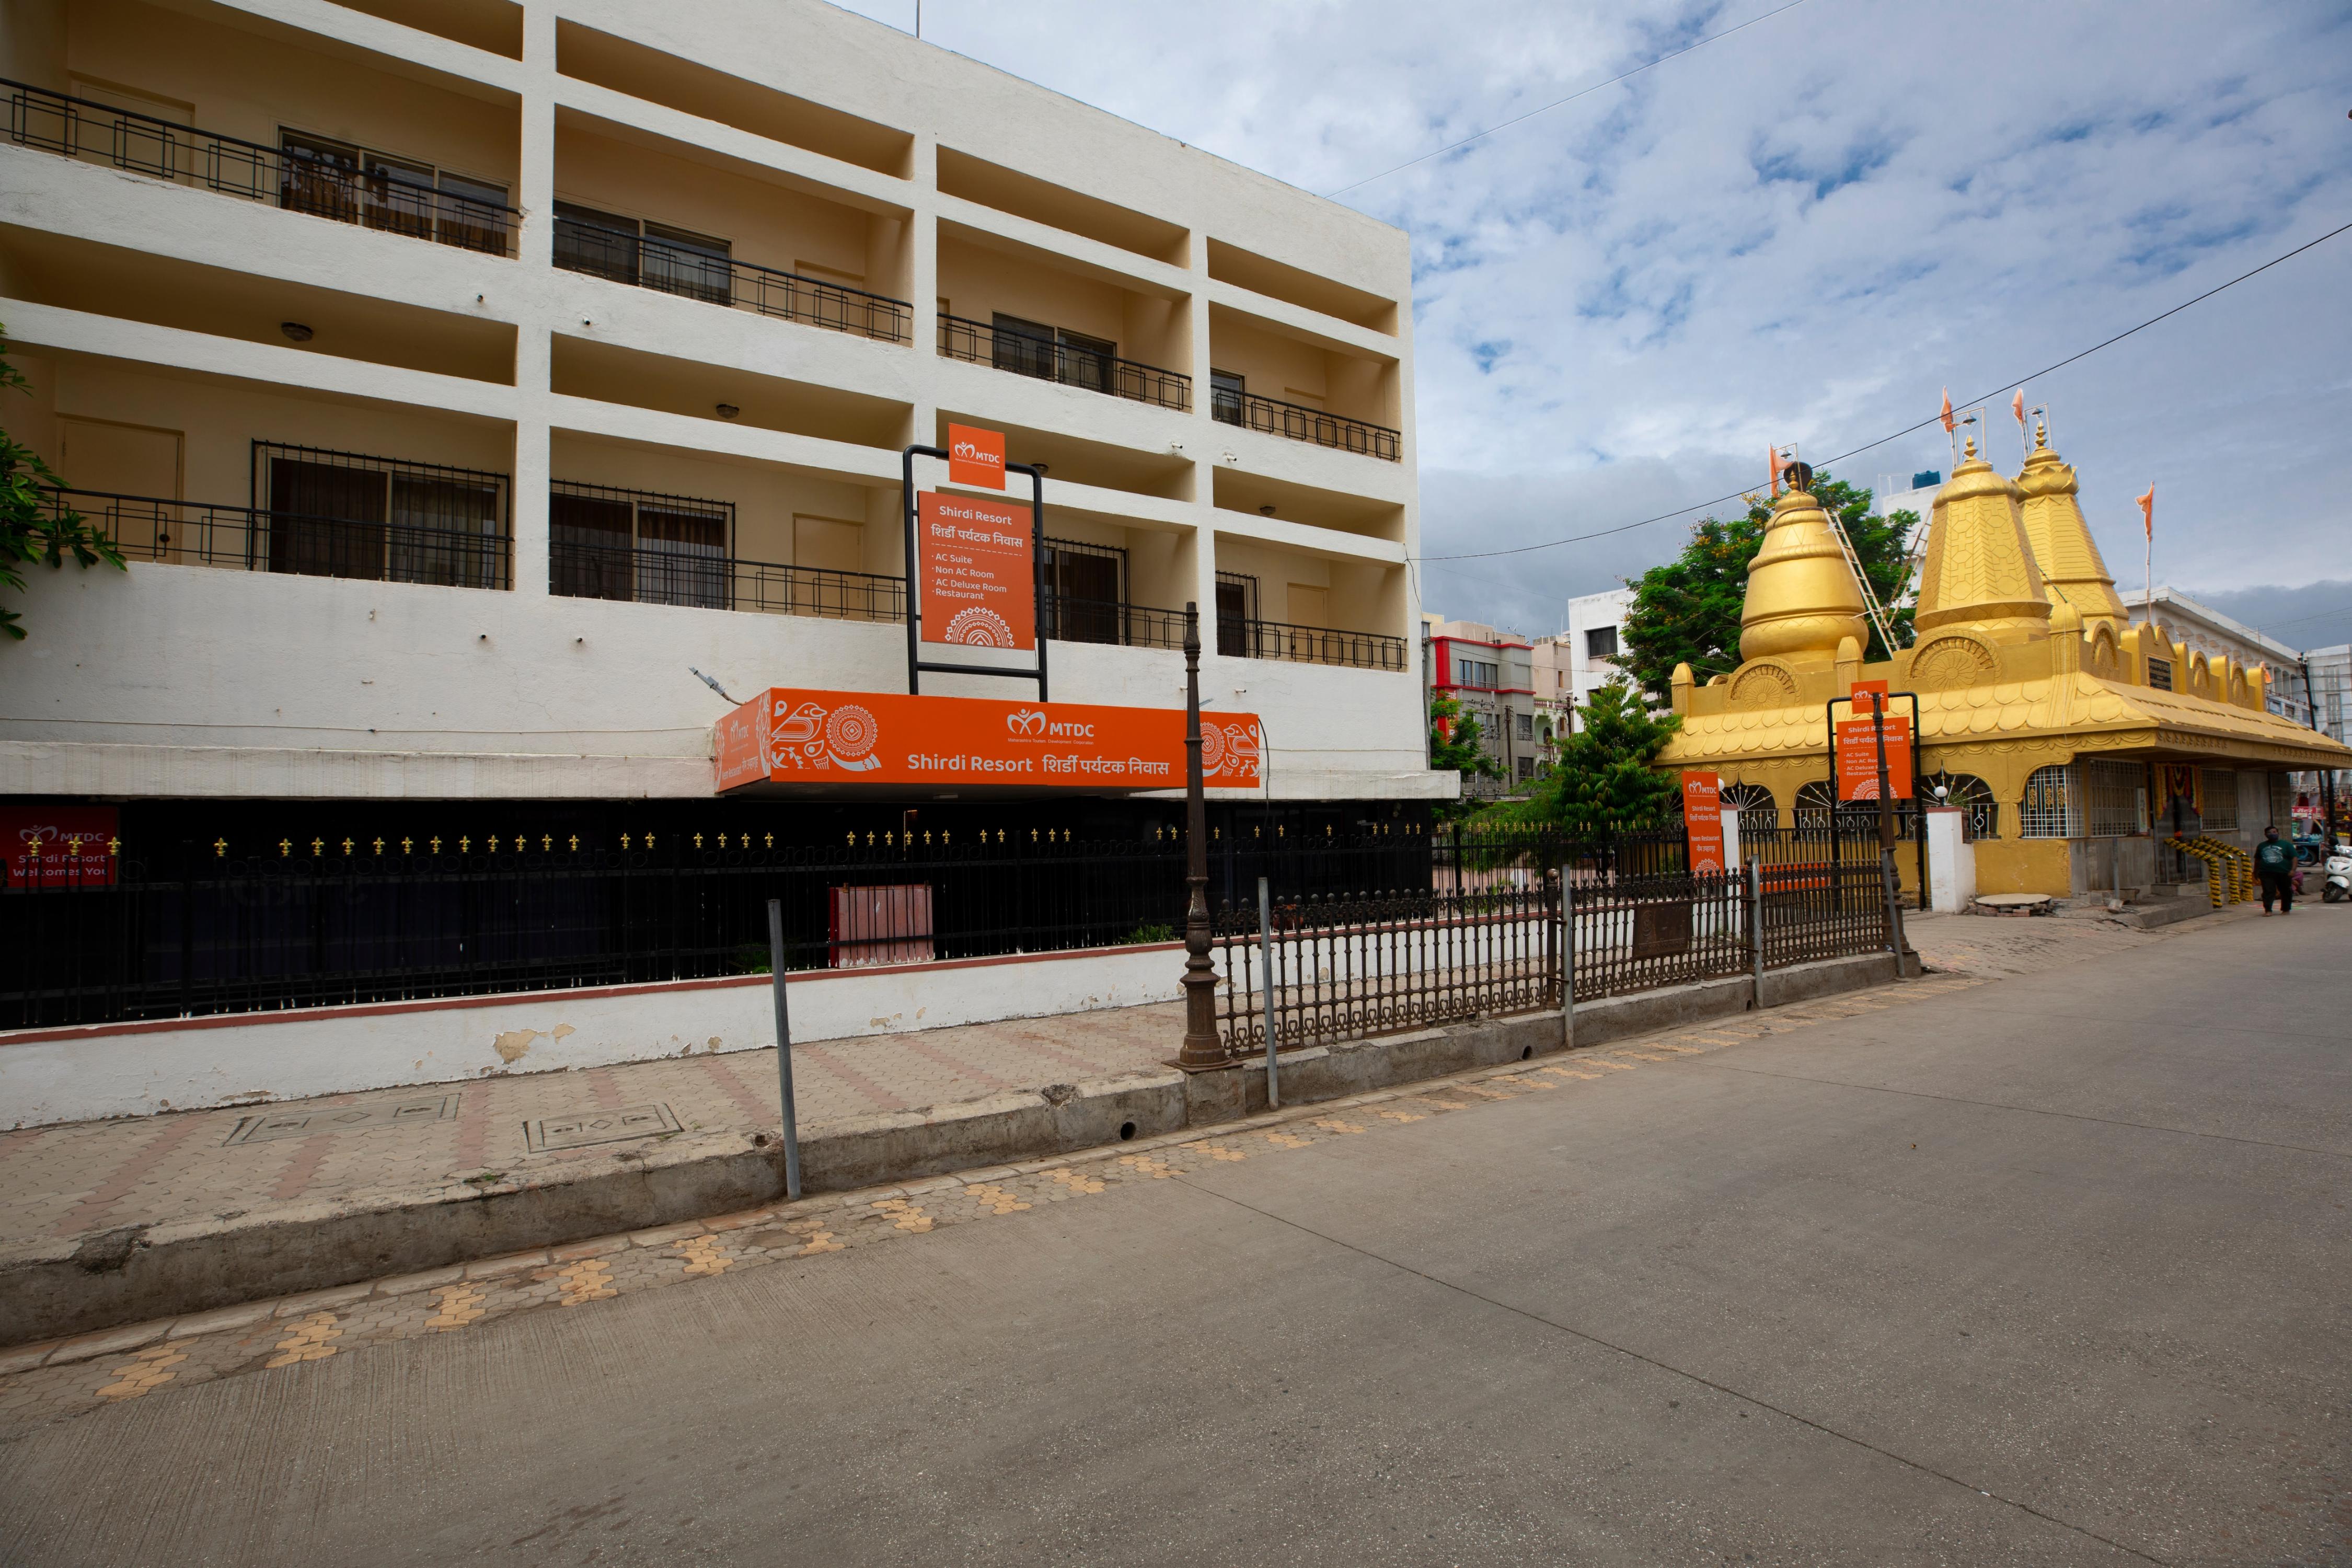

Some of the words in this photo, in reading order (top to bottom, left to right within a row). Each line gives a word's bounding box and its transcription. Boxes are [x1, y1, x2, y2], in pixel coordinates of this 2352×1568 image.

[976, 452, 1000, 464] MTDC
[939, 505, 973, 520] Shirdi
[975, 511, 1012, 525] Resort
[930, 523, 955, 538] शिर्डी
[958, 528, 991, 543] पर्यटक
[992, 532, 1023, 548] निवास
[936, 553, 948, 561] AC
[950, 554, 972, 564] Suite
[936, 566, 953, 574] Non
[956, 568, 967, 576] AC
[970, 569, 994, 579] Room
[936, 578, 948, 586] AC
[951, 580, 981, 590] Deluxe
[983, 583, 1007, 593] Room
[936, 588, 984, 601] Restaurant
[739, 724, 749, 741] MTDC
[1050, 722, 1094, 737] MTDC
[908, 754, 965, 770] Shirdi
[971, 756, 1033, 772] Resort
[1042, 754, 1078, 773] शिर्डी
[1080, 756, 1126, 774] पर्यटक
[1128, 757, 1170, 775] निवास
[60, 833, 105, 842] MTDC
[13, 868, 81, 877] Welomes
